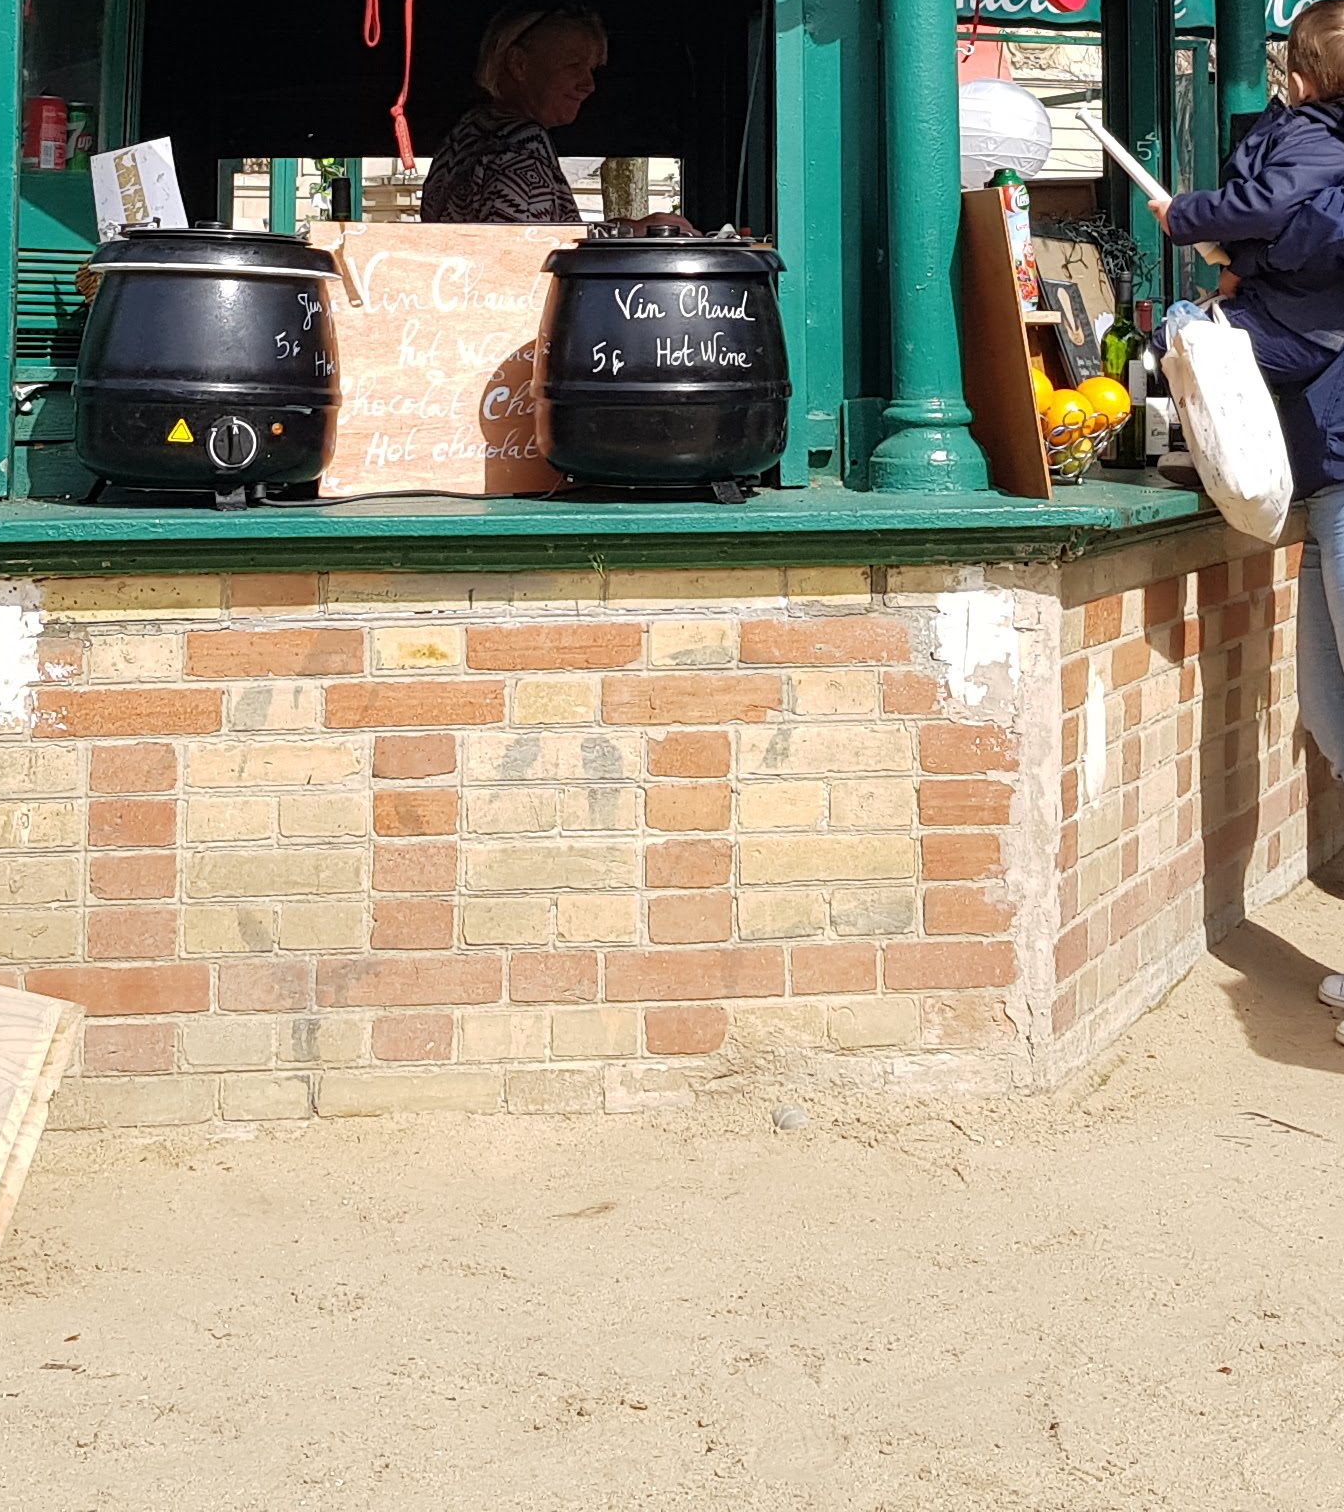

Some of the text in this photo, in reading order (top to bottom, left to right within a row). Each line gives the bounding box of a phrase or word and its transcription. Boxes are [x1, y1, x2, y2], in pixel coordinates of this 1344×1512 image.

[347, 251, 543, 313] Vin Chaud
[614, 284, 756, 321] Vin Chaud
[656, 334, 694, 368] Hot
[700, 332, 753, 368] Wine
[365, 426, 421, 467] Hot
